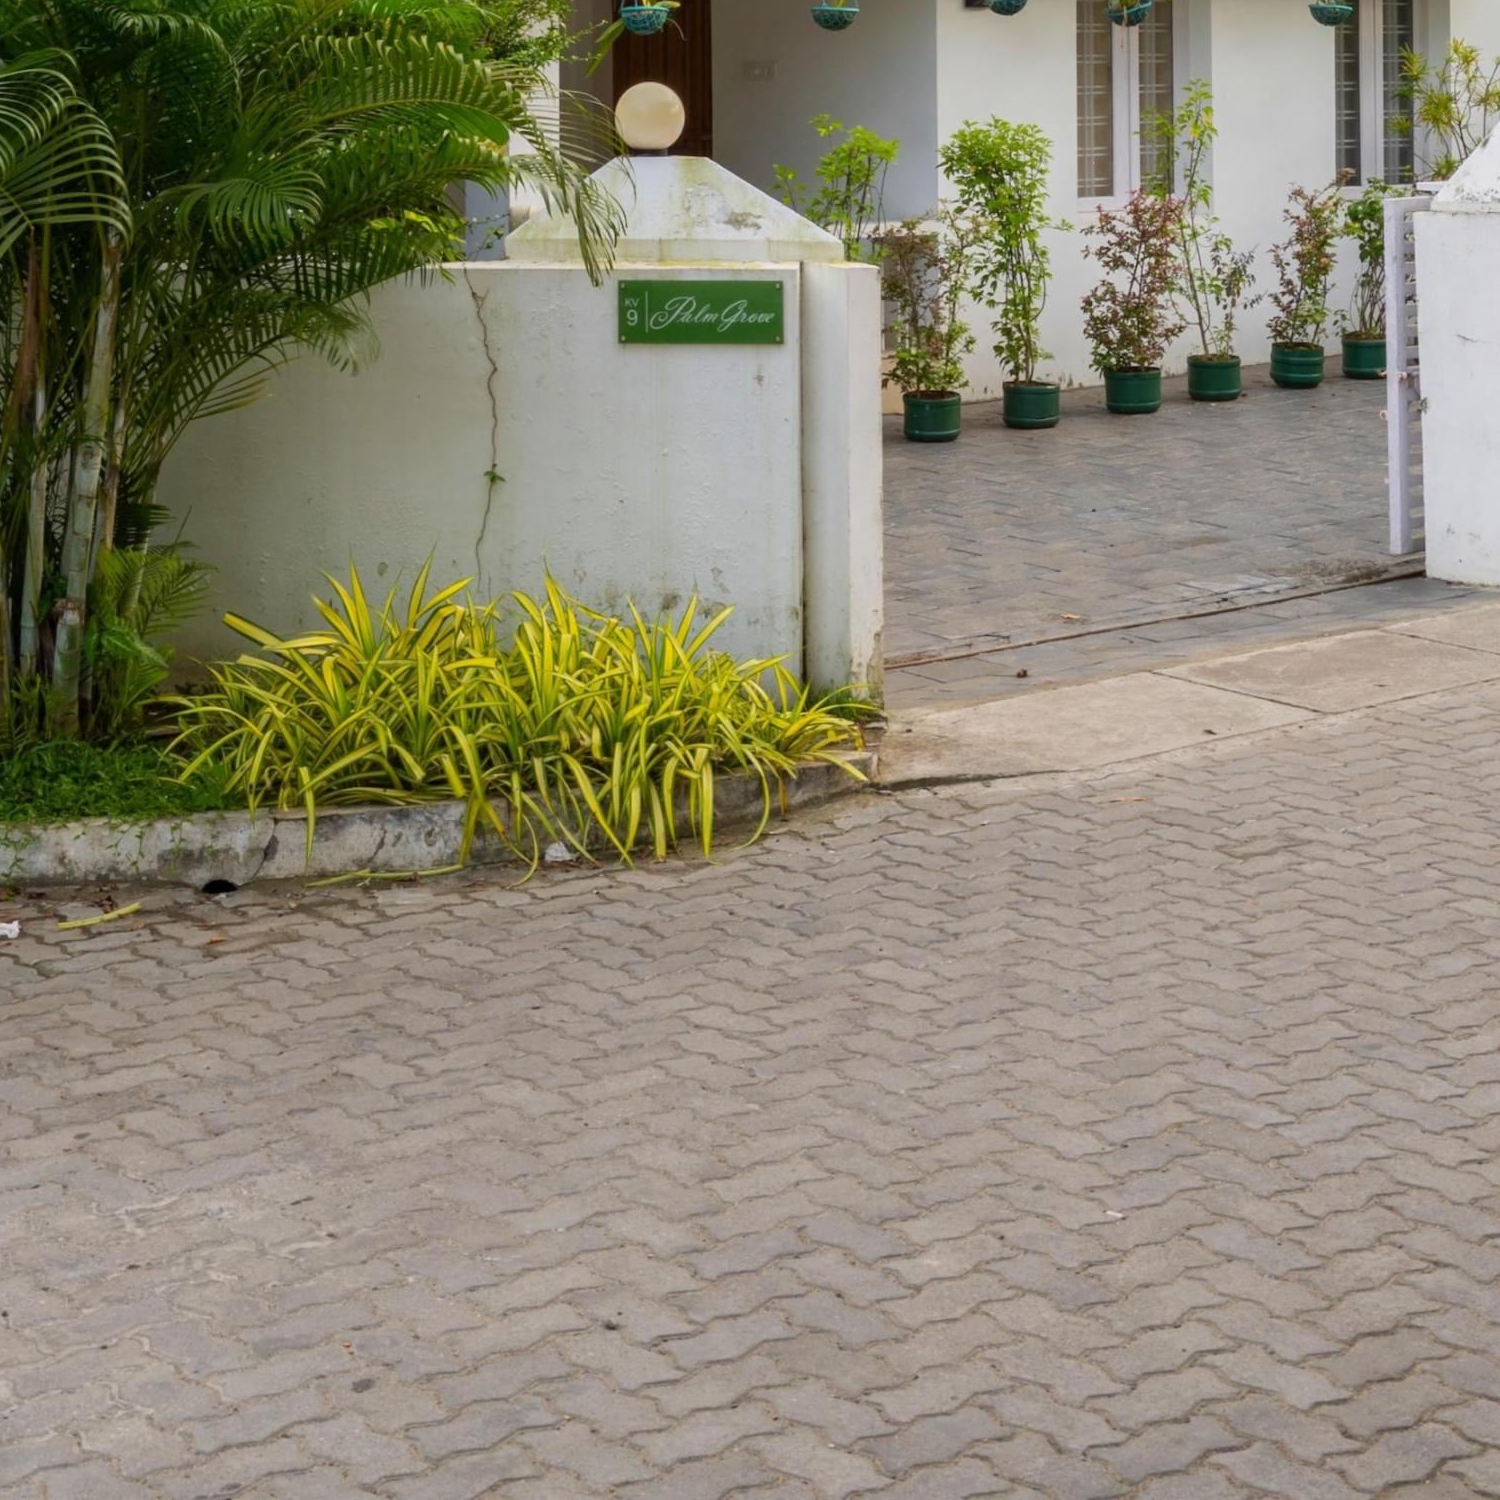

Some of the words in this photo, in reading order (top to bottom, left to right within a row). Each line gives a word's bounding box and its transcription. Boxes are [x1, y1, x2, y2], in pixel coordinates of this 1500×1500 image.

[624, 298, 639, 307] KV
[627, 309, 638, 326] 9
[650, 296, 719, 330] Palm
[716, 299, 775, 333] Grove
